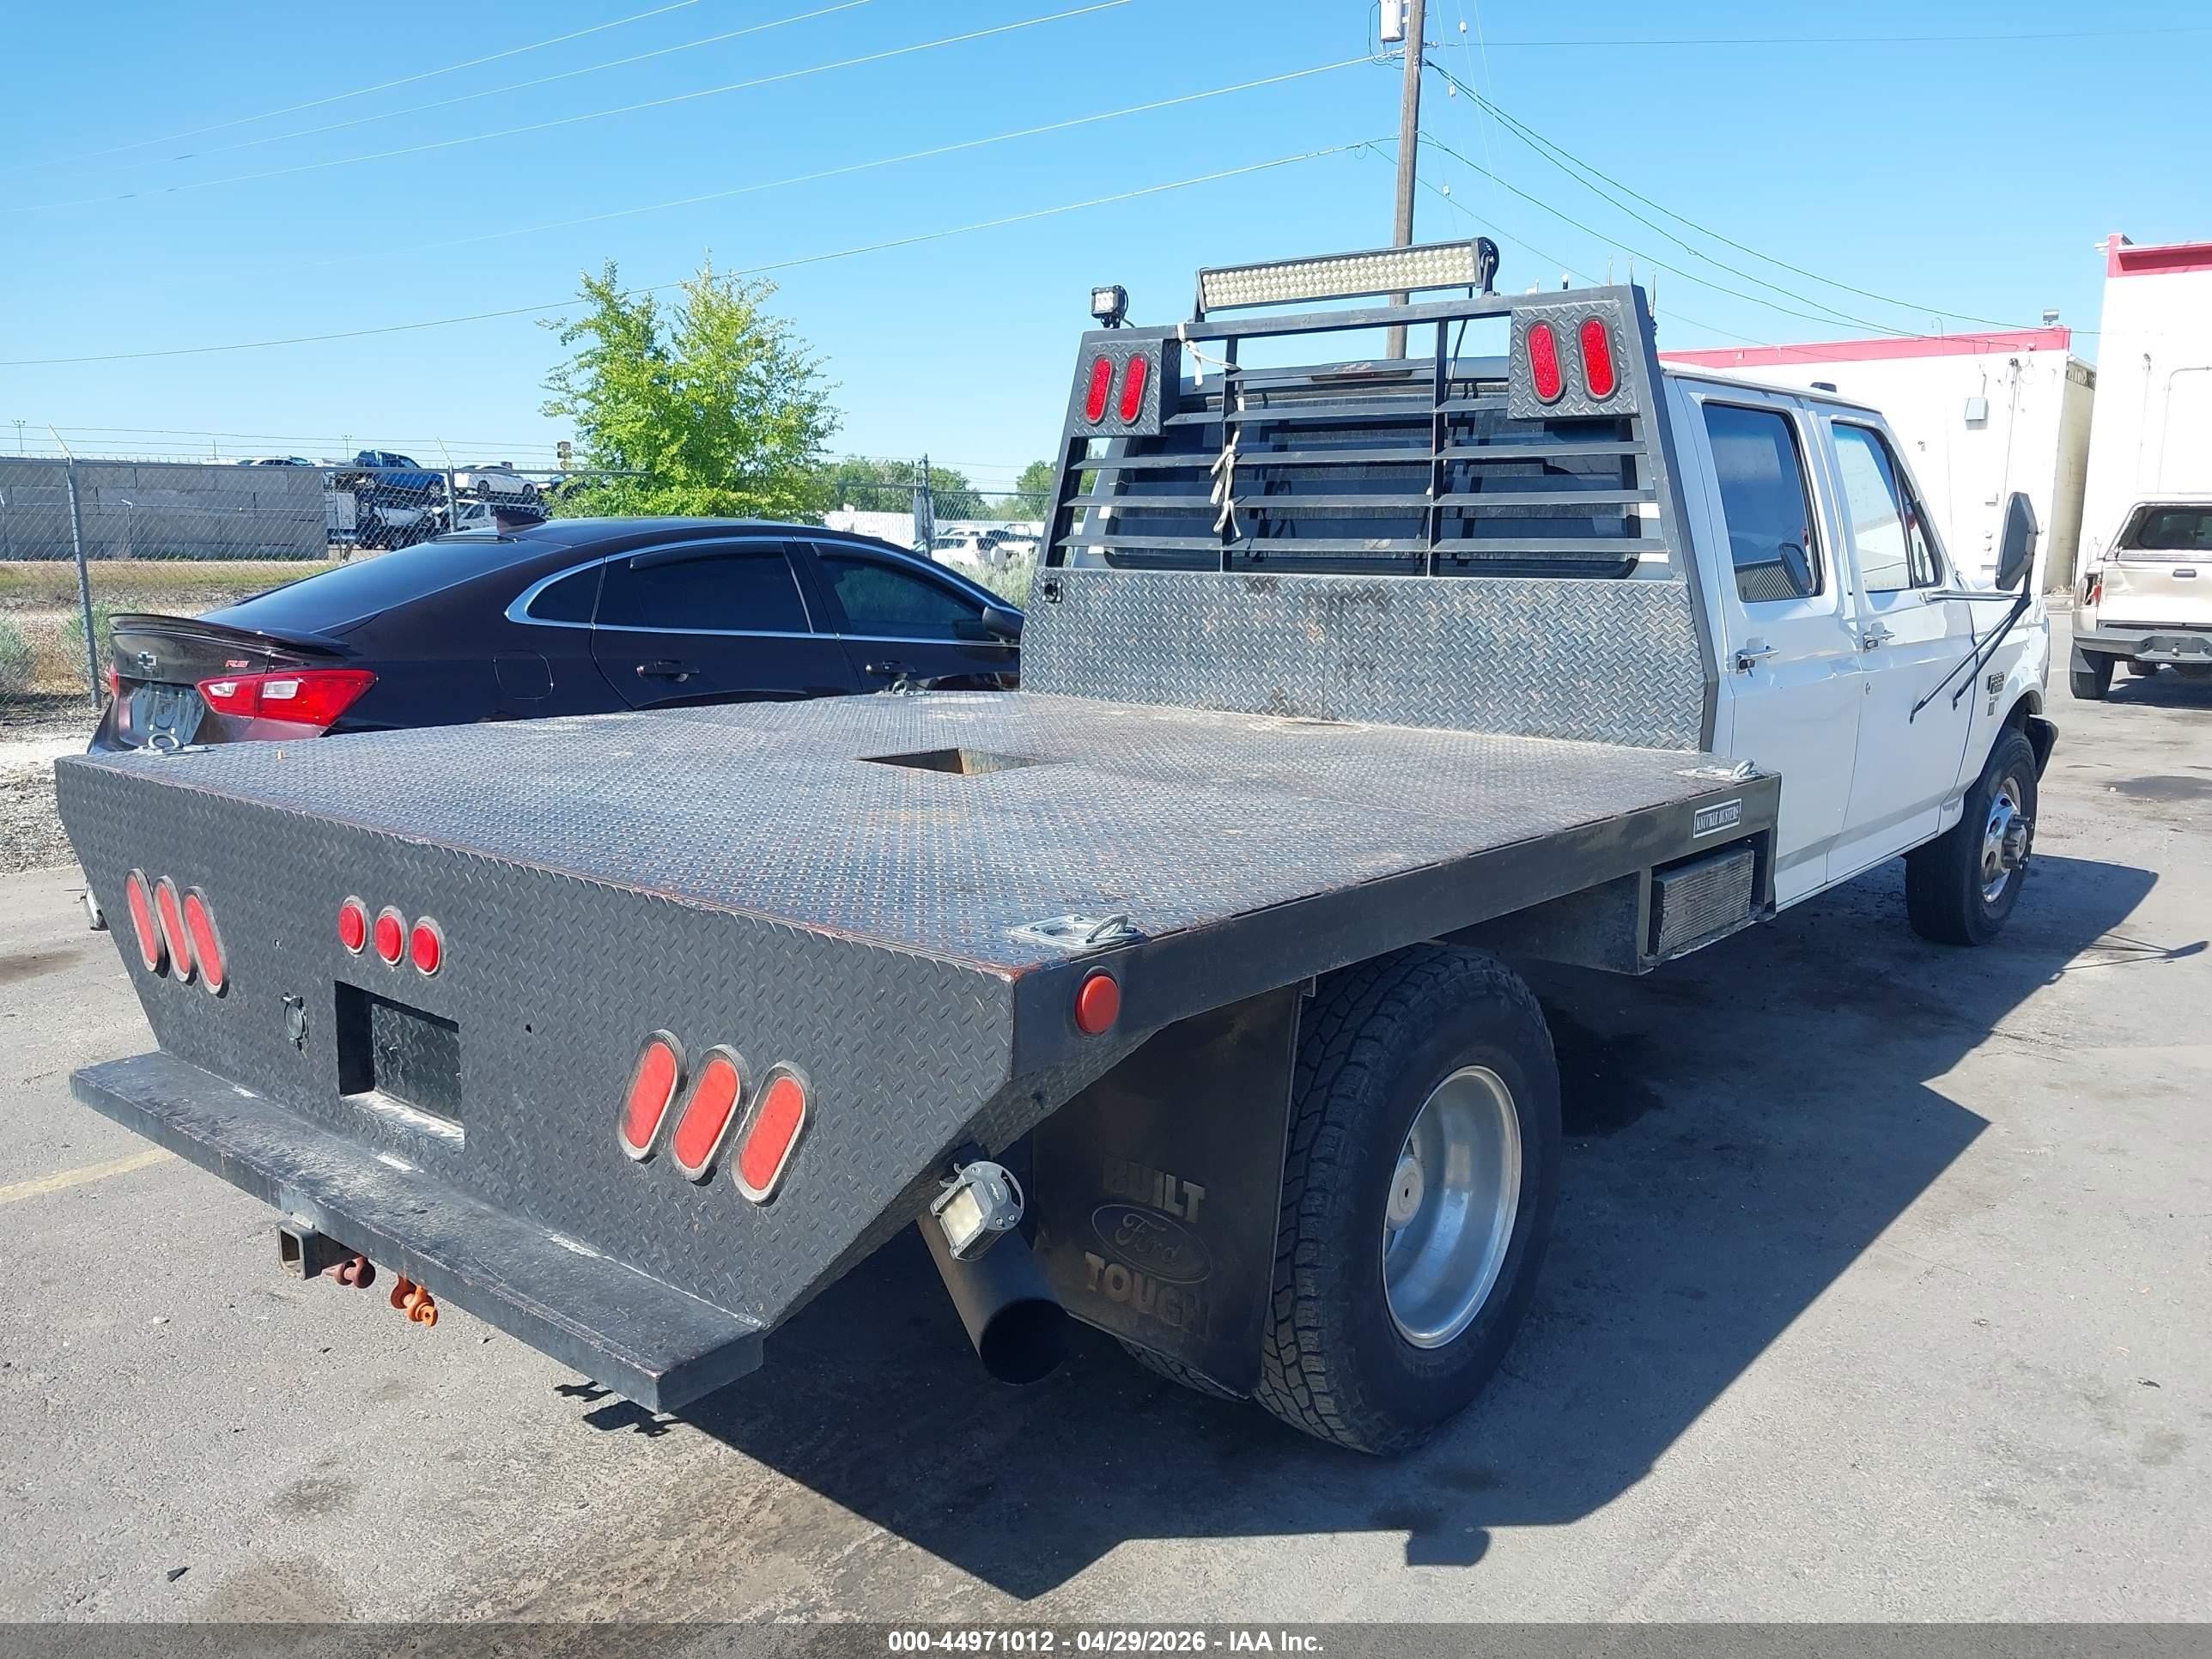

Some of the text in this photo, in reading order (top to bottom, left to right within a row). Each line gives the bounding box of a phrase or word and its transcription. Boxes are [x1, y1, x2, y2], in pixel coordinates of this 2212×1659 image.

[225, 659, 250, 668] RS
[1103, 1153, 1206, 1223] BUILT
[1115, 1212, 1182, 1266] Ford
